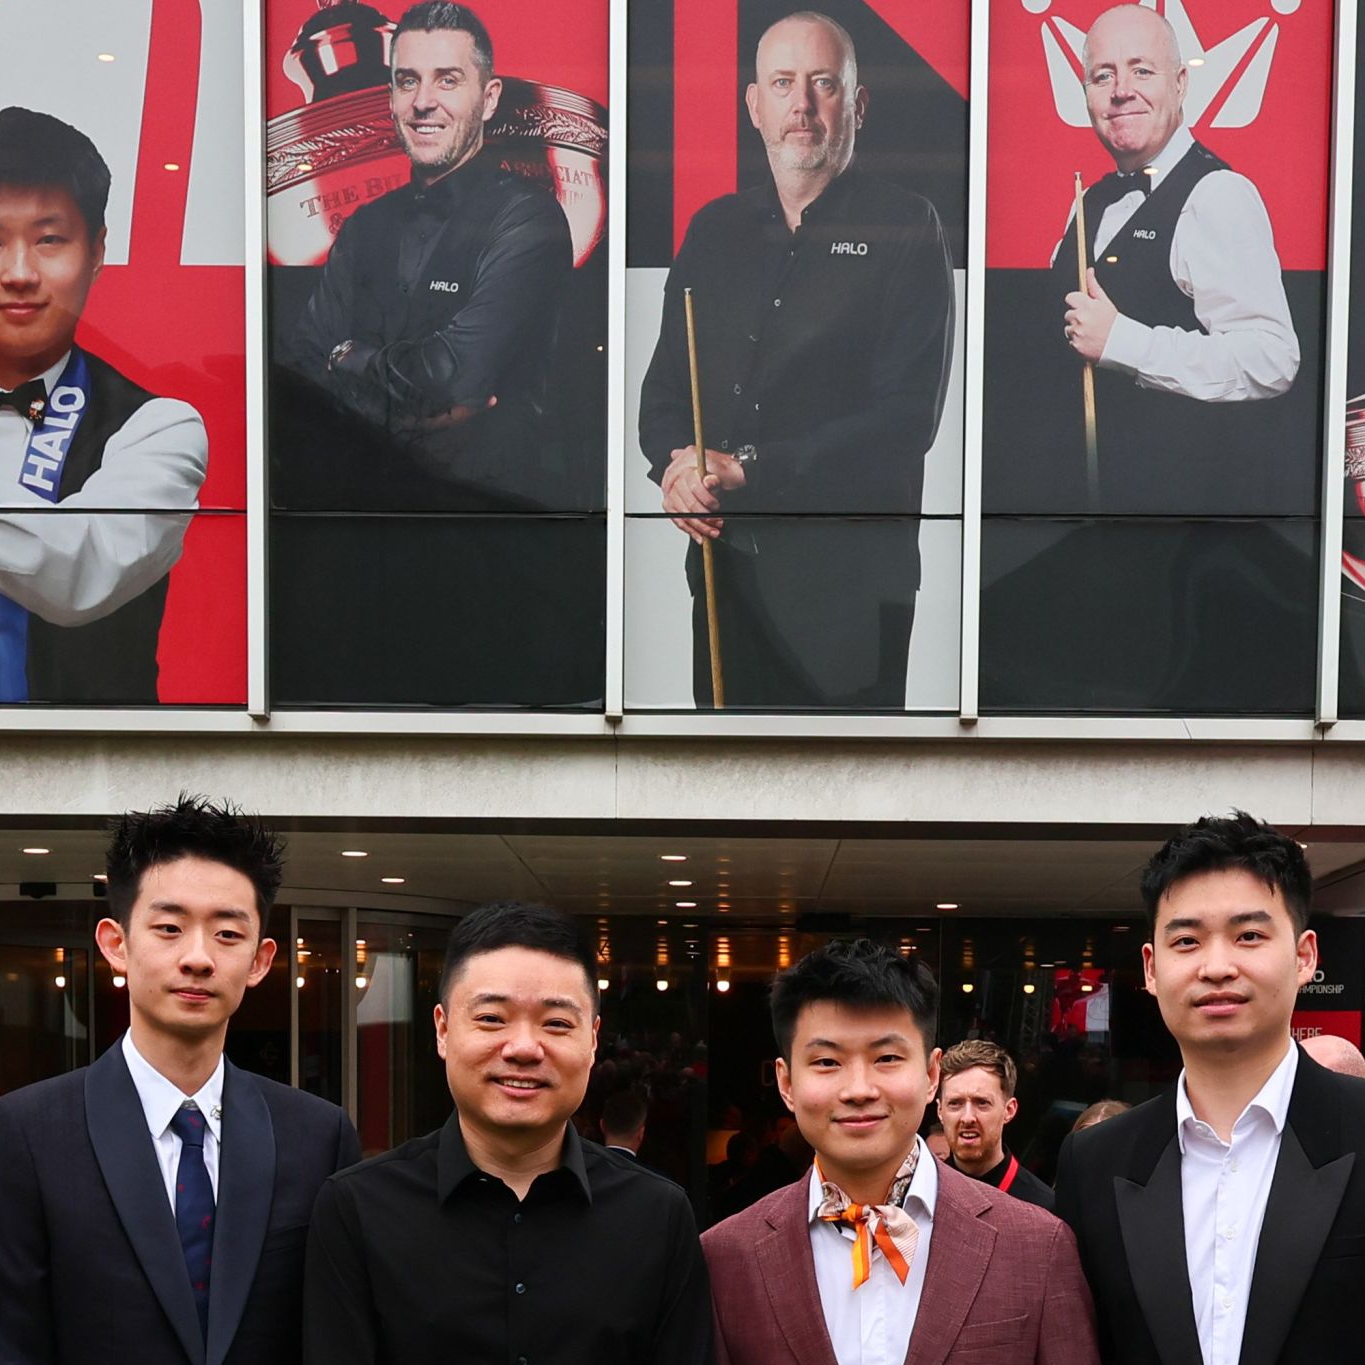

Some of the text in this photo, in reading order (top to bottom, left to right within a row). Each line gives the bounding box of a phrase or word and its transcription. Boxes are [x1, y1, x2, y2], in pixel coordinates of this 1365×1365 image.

[299, 186, 360, 218] THE
[1133, 229, 1156, 240] HALO
[830, 242, 868, 256] HALO
[429, 280, 459, 293] HALO
[22, 385, 85, 492] HALO
